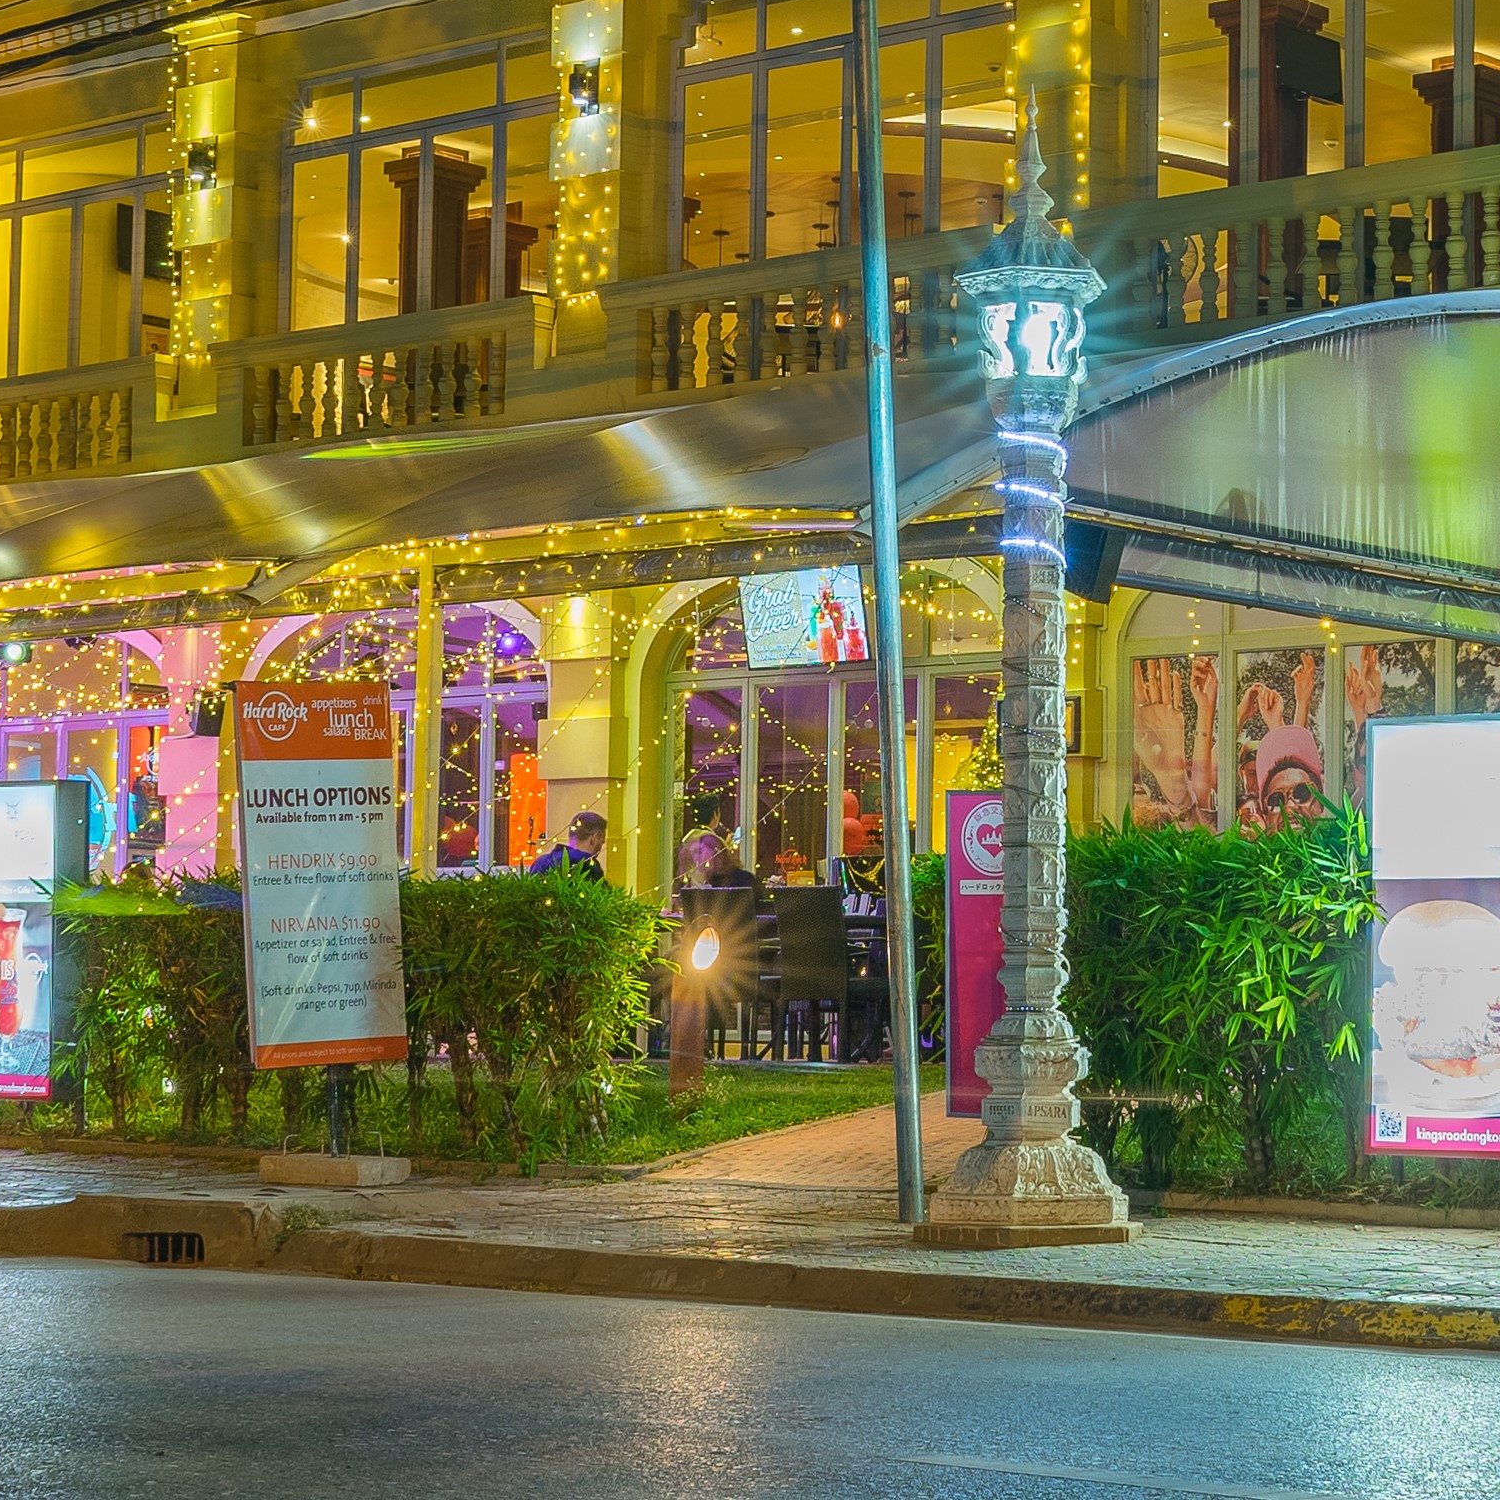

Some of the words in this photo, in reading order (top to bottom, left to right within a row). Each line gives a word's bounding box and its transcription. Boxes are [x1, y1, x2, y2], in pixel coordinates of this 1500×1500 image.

[748, 579, 795, 614] Grab
[747, 609, 800, 641] Cheer
[243, 702, 276, 719] Hard
[277, 702, 308, 722] Rock
[311, 697, 357, 712] appetizers
[268, 723, 286, 731] CAFE
[329, 708, 374, 728] lunch
[323, 725, 352, 737] salads
[354, 728, 388, 741] BREAK
[246, 788, 309, 808] LUNCH
[313, 786, 392, 807] OPTIONS
[256, 811, 302, 824] Available
[304, 811, 328, 823] from
[329, 813, 337, 822] 11
[338, 813, 354, 822] am
[361, 812, 367, 824] 5
[368, 812, 384, 824] pm
[268, 853, 336, 870] HENDRIX
[339, 852, 378, 871] $9.90
[253, 875, 282, 886] Entree
[284, 874, 293, 885] &
[294, 873, 314, 884] free
[316, 872, 336, 884] flow
[337, 871, 347, 883] of
[349, 871, 366, 882] soft
[367, 871, 394, 882] drinks
[271, 915, 339, 933] NIRVANA
[341, 914, 381, 933] $11.90
[254, 939, 298, 953] Appetizer
[300, 939, 310, 948] or
[339, 935, 368, 946] Entree
[369, 933, 378, 944] &
[379, 933, 397, 944] free
[287, 953, 309, 964] flow
[311, 952, 321, 963] of
[323, 951, 340, 962] soft
[341, 950, 369, 961] drinks
[261, 985, 283, 999] (Soft
[284, 984, 316, 997] drinks:
[317, 982, 343, 996] Pepsi,
[344, 983, 362, 995] 7up,
[363, 979, 397, 991] Mirinda
[295, 1000, 326, 1012] orange
[328, 999, 338, 1009] or
[339, 996, 368, 1012] green)
[1027, 1105, 1067, 1119] APSARA
